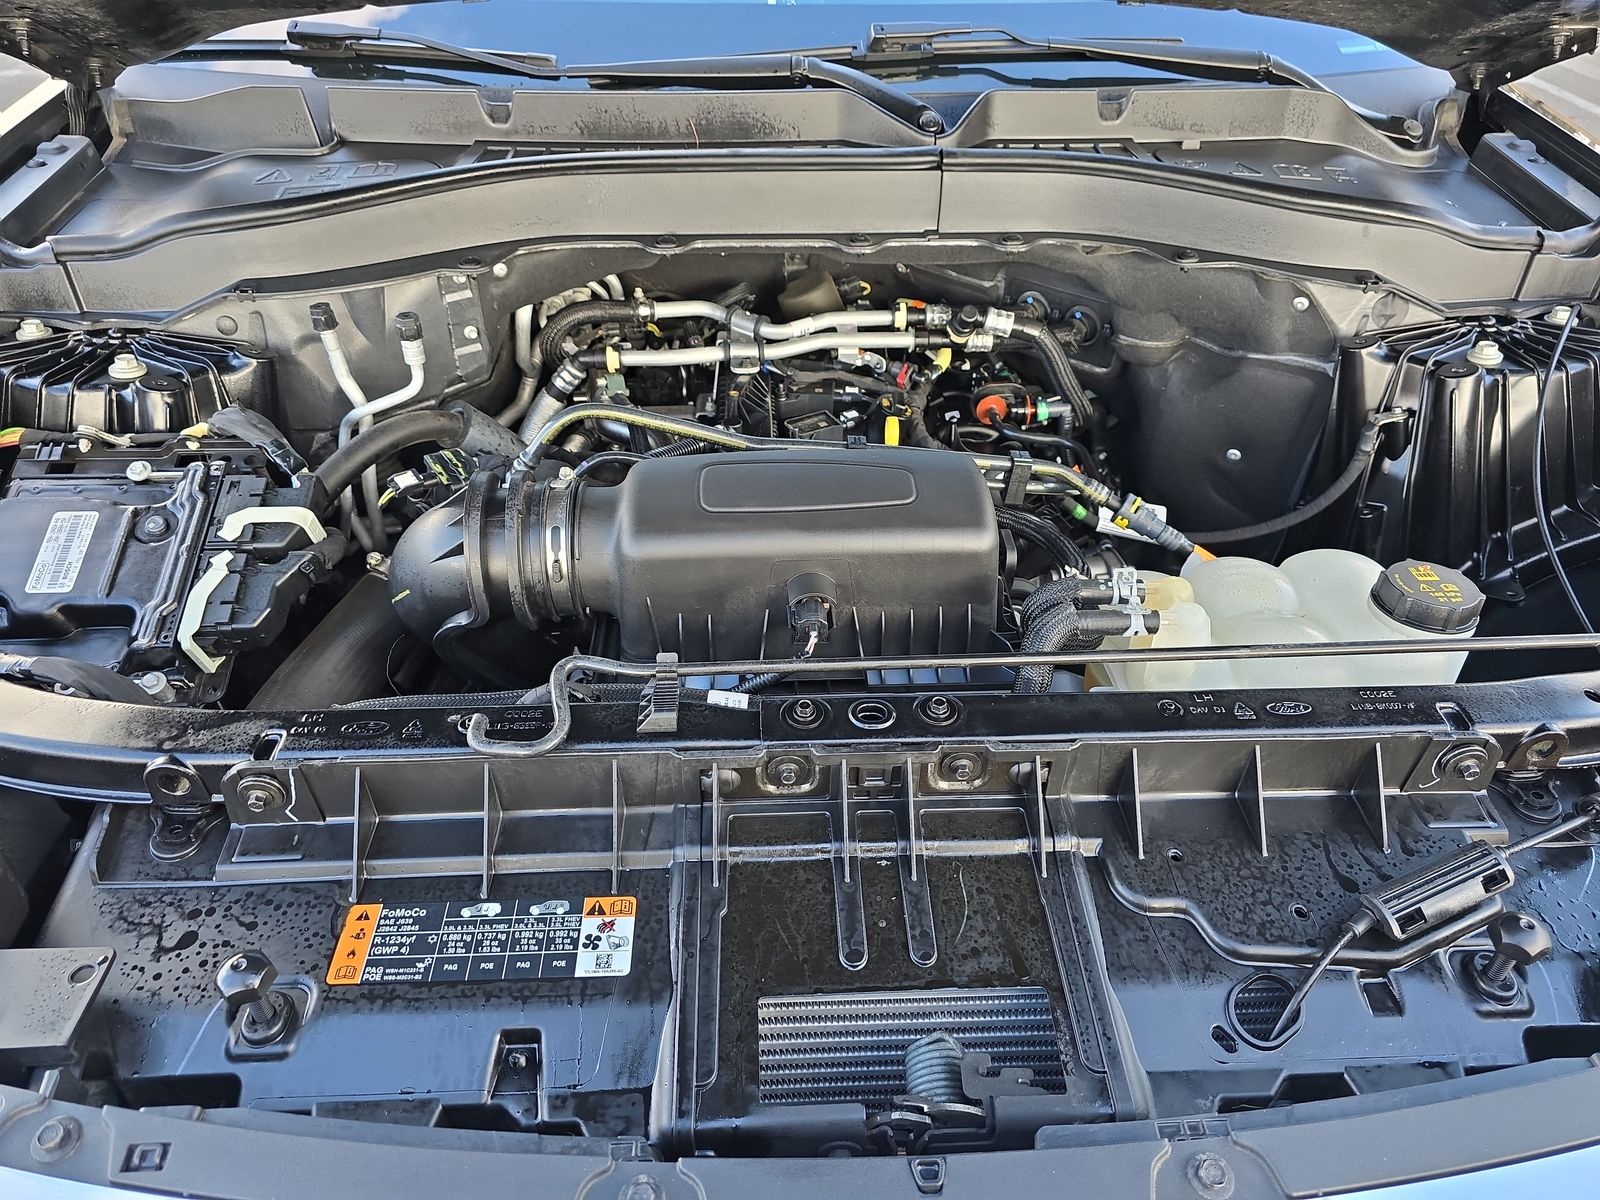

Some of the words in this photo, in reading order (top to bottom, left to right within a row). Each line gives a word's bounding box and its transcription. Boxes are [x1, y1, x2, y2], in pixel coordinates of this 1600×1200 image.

[32, 564, 47, 588] FoMoCo
[1194, 694, 1214, 702] LH
[1275, 702, 1305, 713] Ford
[381, 908, 426, 917] FoMoCo
[374, 935, 416, 944] R-1234yf
[371, 946, 399, 955] (GWP
[400, 946, 410, 955] 4)
